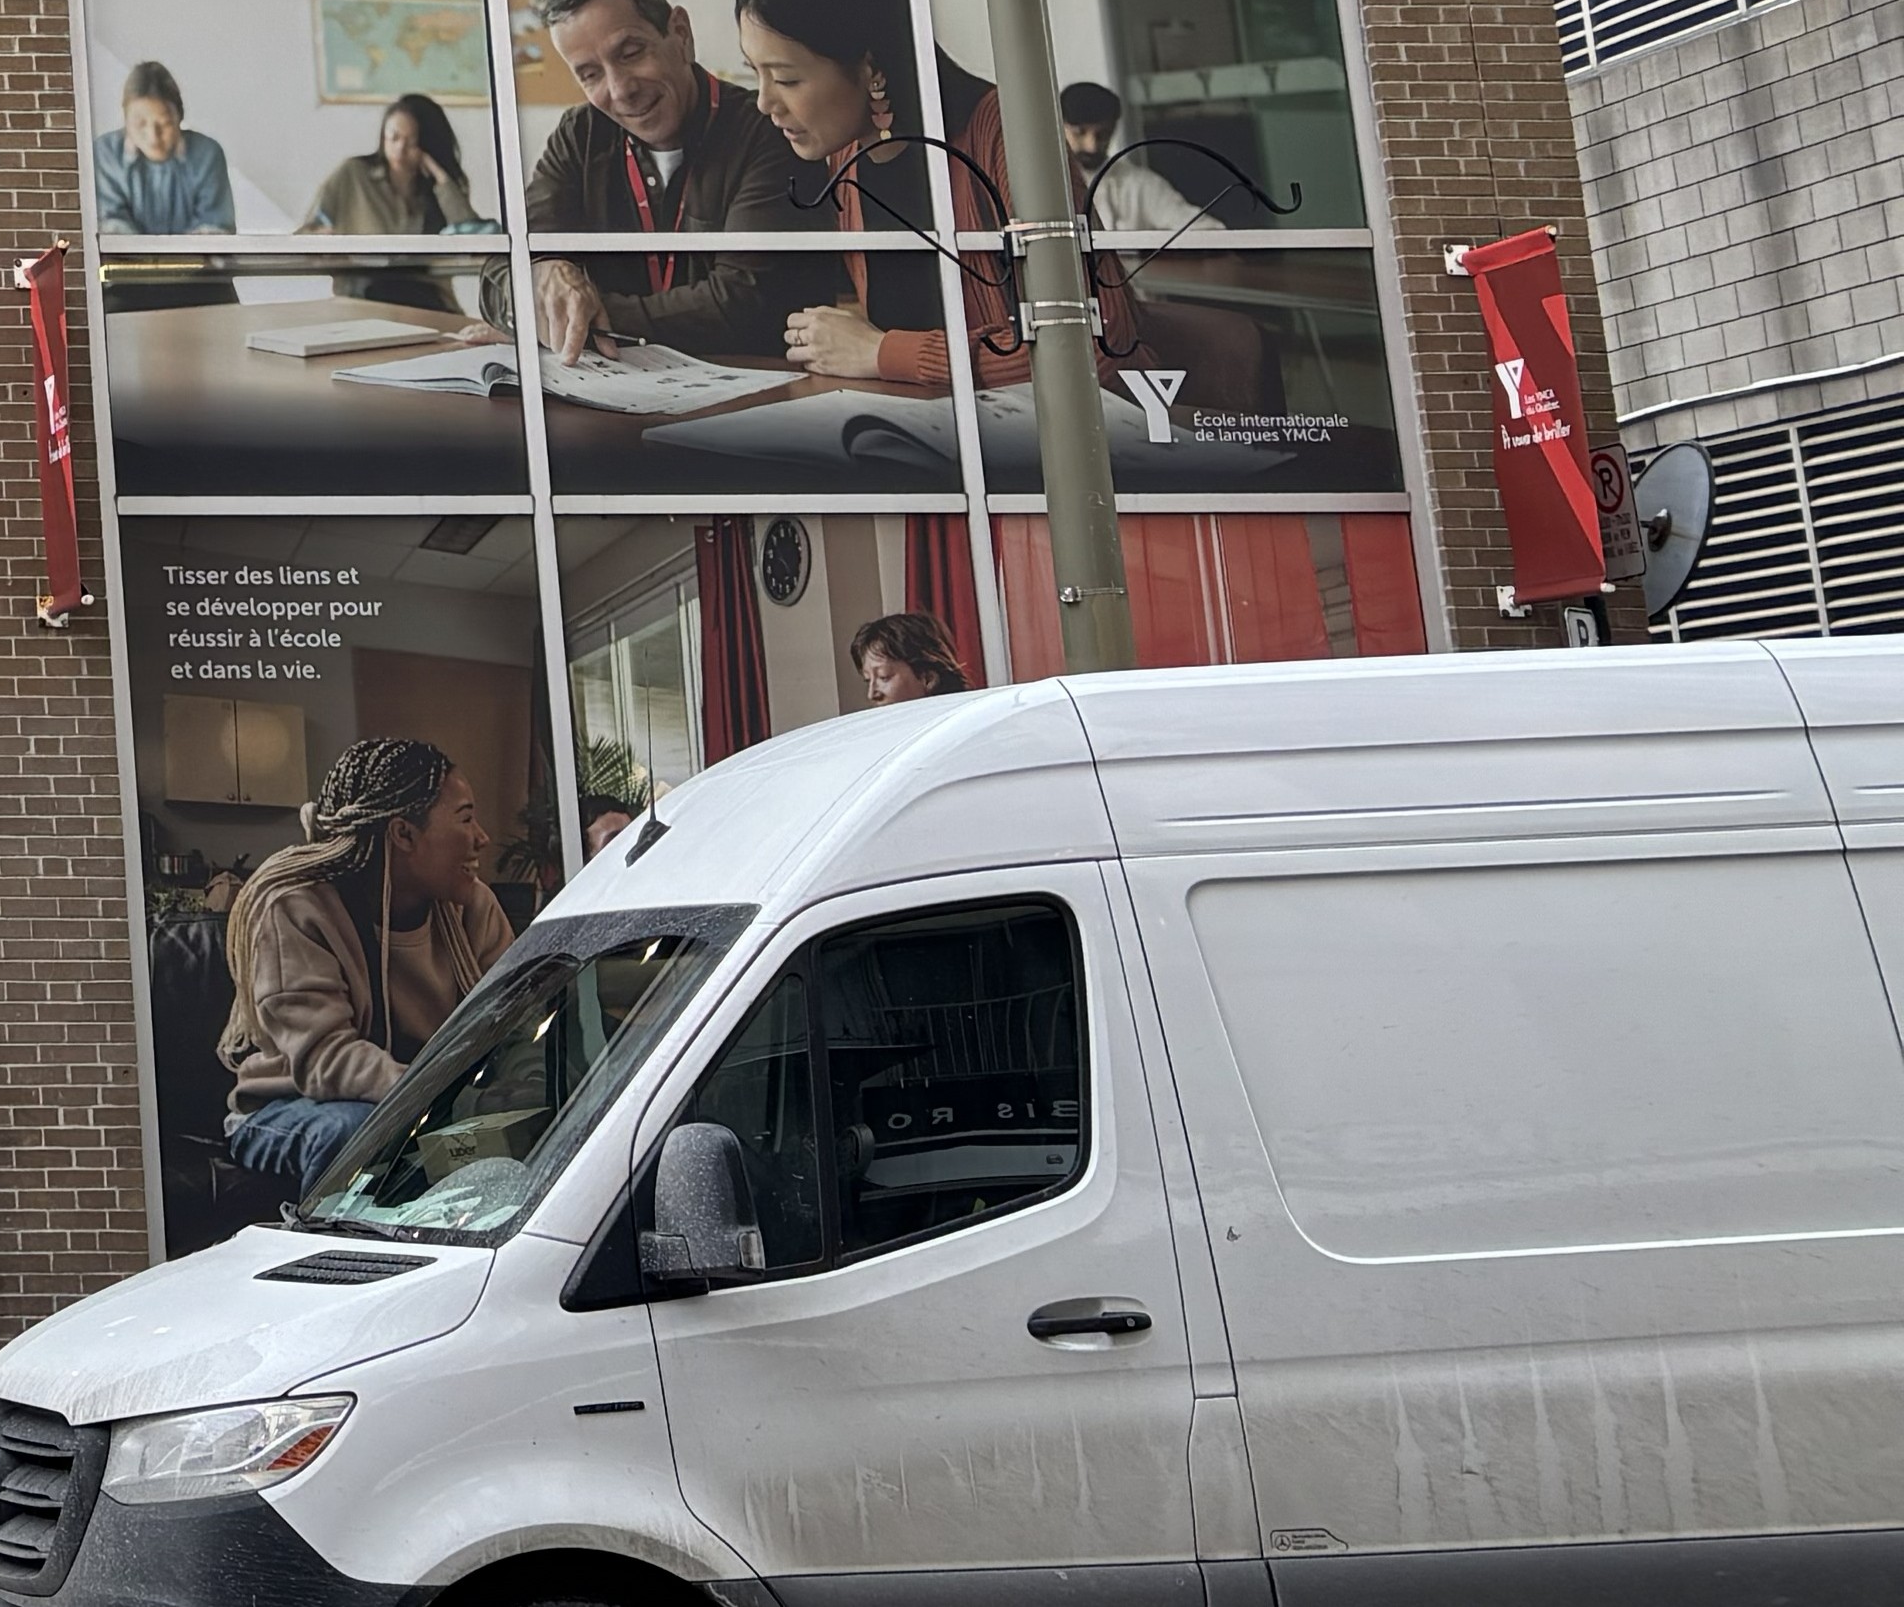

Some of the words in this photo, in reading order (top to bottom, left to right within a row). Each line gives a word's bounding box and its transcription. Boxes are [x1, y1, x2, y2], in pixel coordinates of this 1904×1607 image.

[1193, 410, 1237, 427] École
[1240, 412, 1349, 428] internationale
[1195, 428, 1215, 442] de
[1219, 427, 1280, 444] langues
[1283, 427, 1331, 442] YMCA
[162, 565, 229, 585] Tisser
[234, 565, 273, 585] des
[279, 565, 331, 585] liens
[337, 567, 360, 585] et
[166, 601, 190, 616] se
[196, 597, 323, 620] développer
[329, 600, 382, 620] pour
[168, 628, 243, 647] réussir
[248, 628, 261, 647] à
[267, 627, 341, 647] l'école
[170, 661, 193, 679] et
[198, 659, 252, 679] dans
[257, 659, 277, 679] la
[282, 660, 321, 679] vie.
